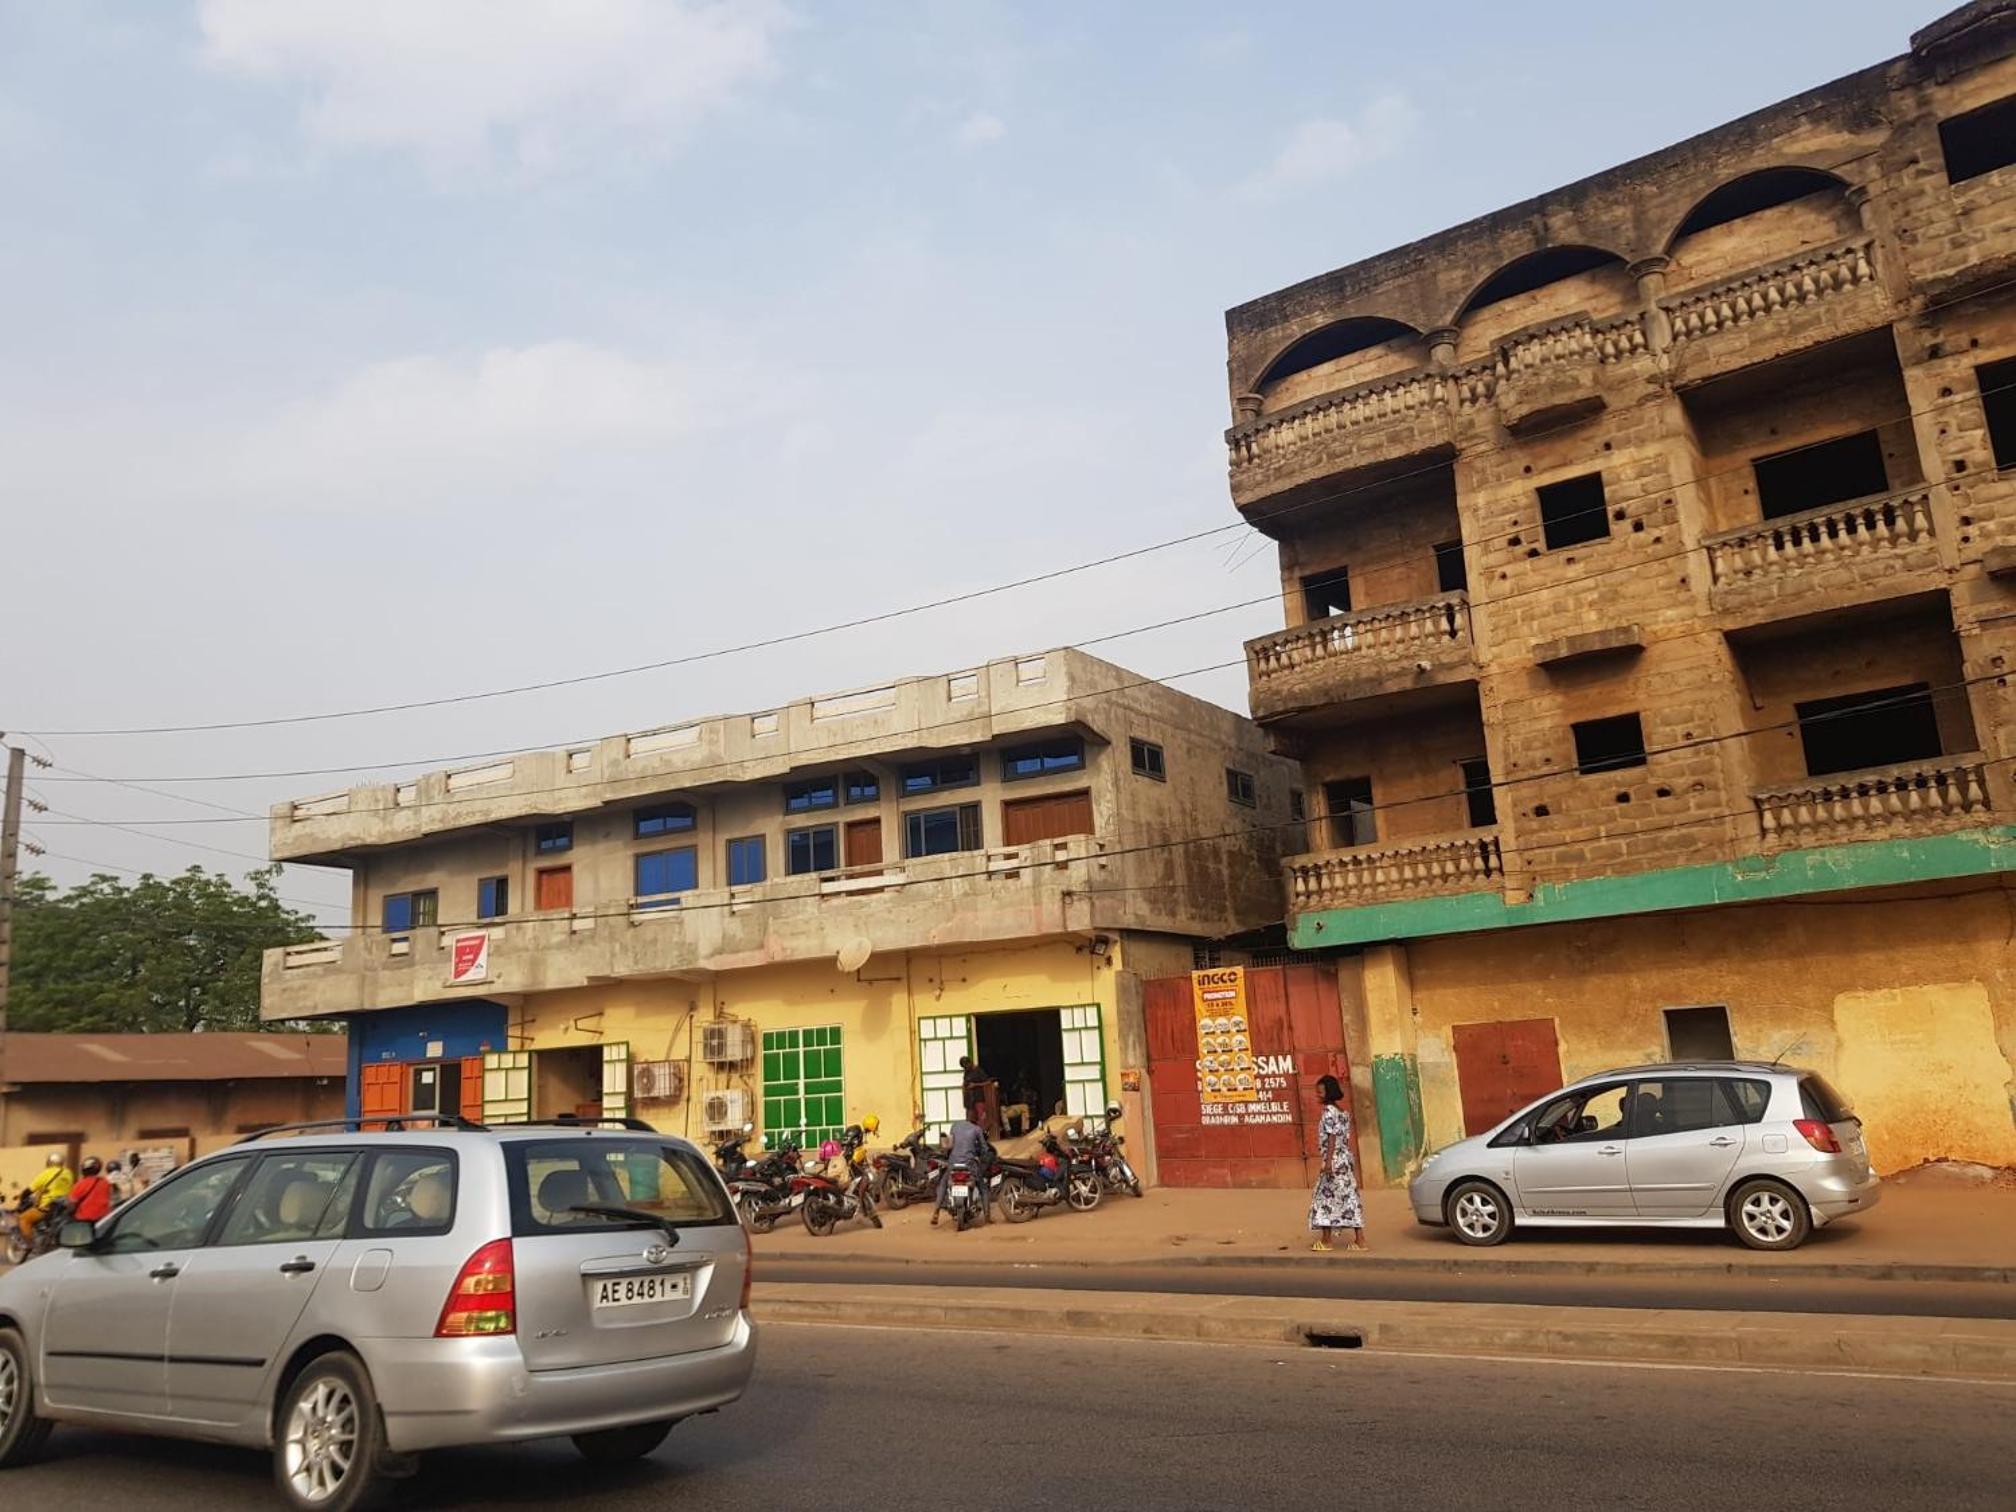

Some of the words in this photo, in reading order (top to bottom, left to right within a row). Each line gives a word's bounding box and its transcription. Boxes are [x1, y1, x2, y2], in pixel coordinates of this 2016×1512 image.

[1264, 1077, 1287, 1089] 2575
[600, 1281, 621, 1303] AE
[625, 1278, 665, 1300] 8481
